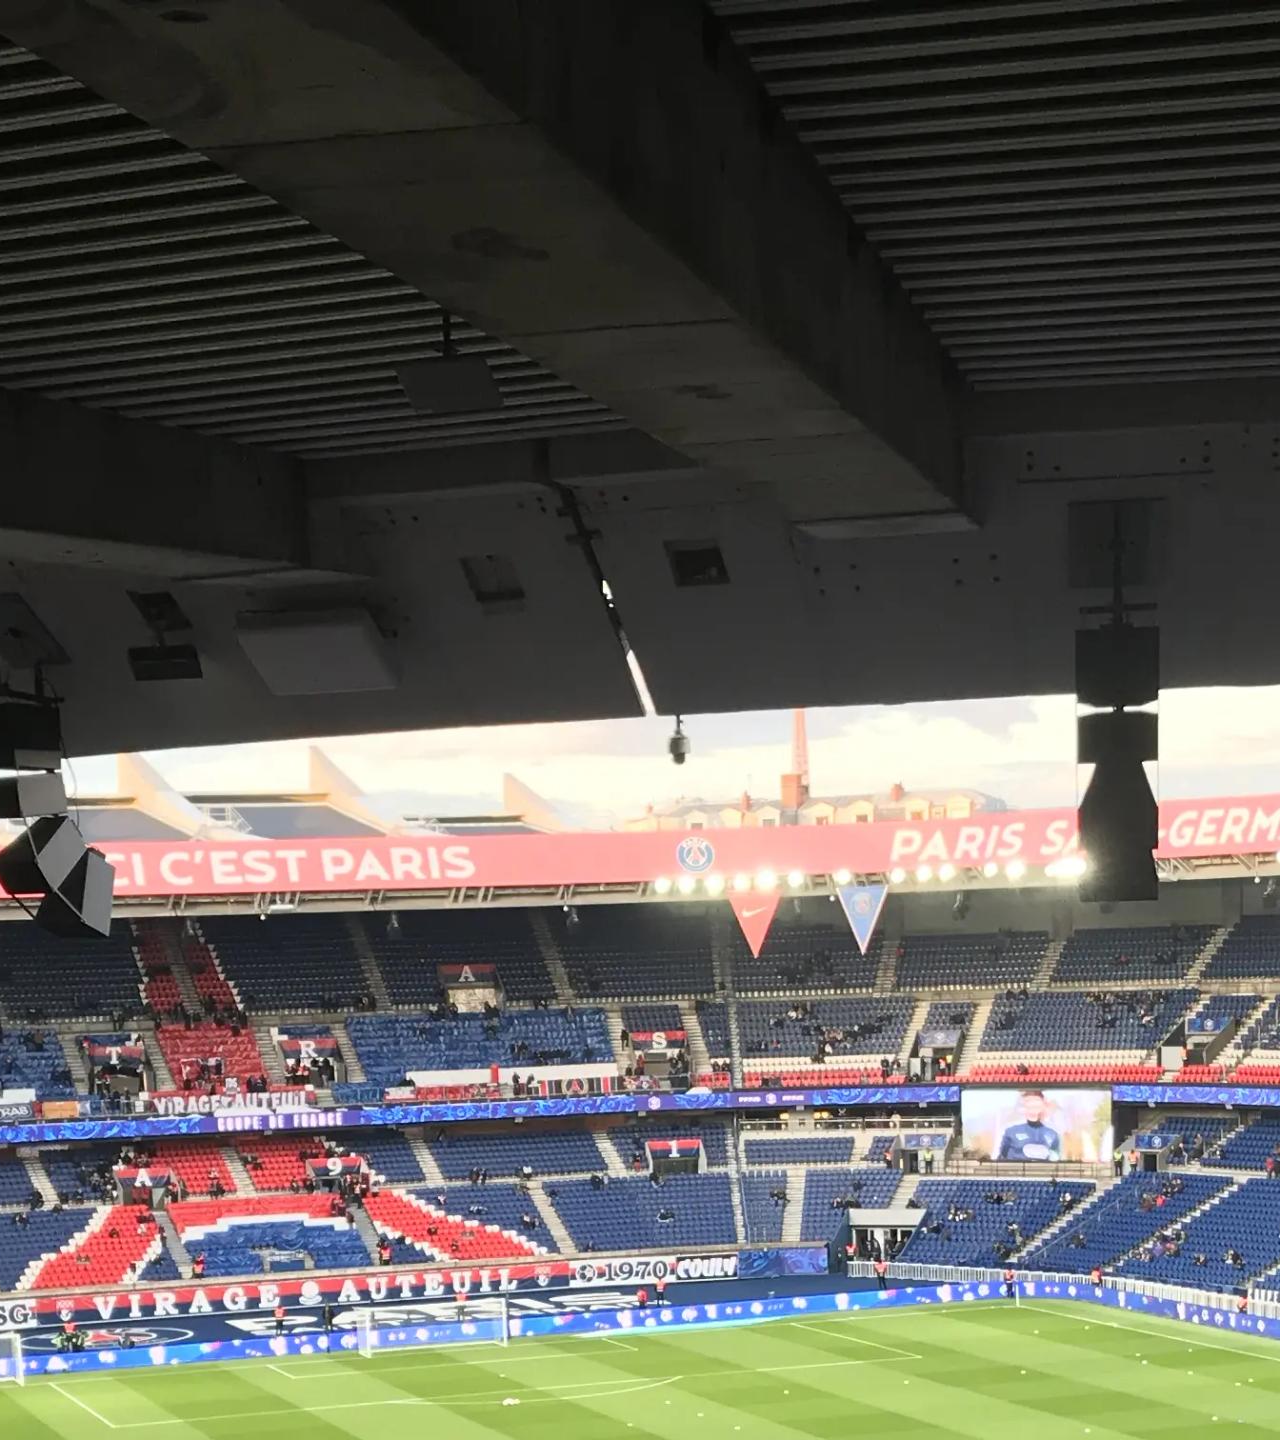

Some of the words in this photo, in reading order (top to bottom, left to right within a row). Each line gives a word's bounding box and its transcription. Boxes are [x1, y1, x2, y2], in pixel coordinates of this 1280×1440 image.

[890, 822, 1025, 862] PARIS
[159, 848, 308, 886] C'EST
[321, 846, 476, 882] PARIS
[458, 965, 476, 982] A
[298, 1040, 318, 1058] R
[651, 1031, 667, 1049] S
[105, 1046, 122, 1065] T
[153, 1095, 222, 1115] VIRAGE
[235, 1090, 307, 1110] AUTEUIL
[217, 1115, 263, 1131] COUPE
[270, 1115, 284, 1129] DE
[293, 1111, 344, 1127] FRANCE
[668, 1140, 680, 1158] 1
[326, 1157, 343, 1176] 9
[134, 1168, 153, 1187] A
[603, 1260, 669, 1282] 1970
[93, 1284, 281, 1320] VIRAGE
[338, 1267, 518, 1304] AUTEUIL
